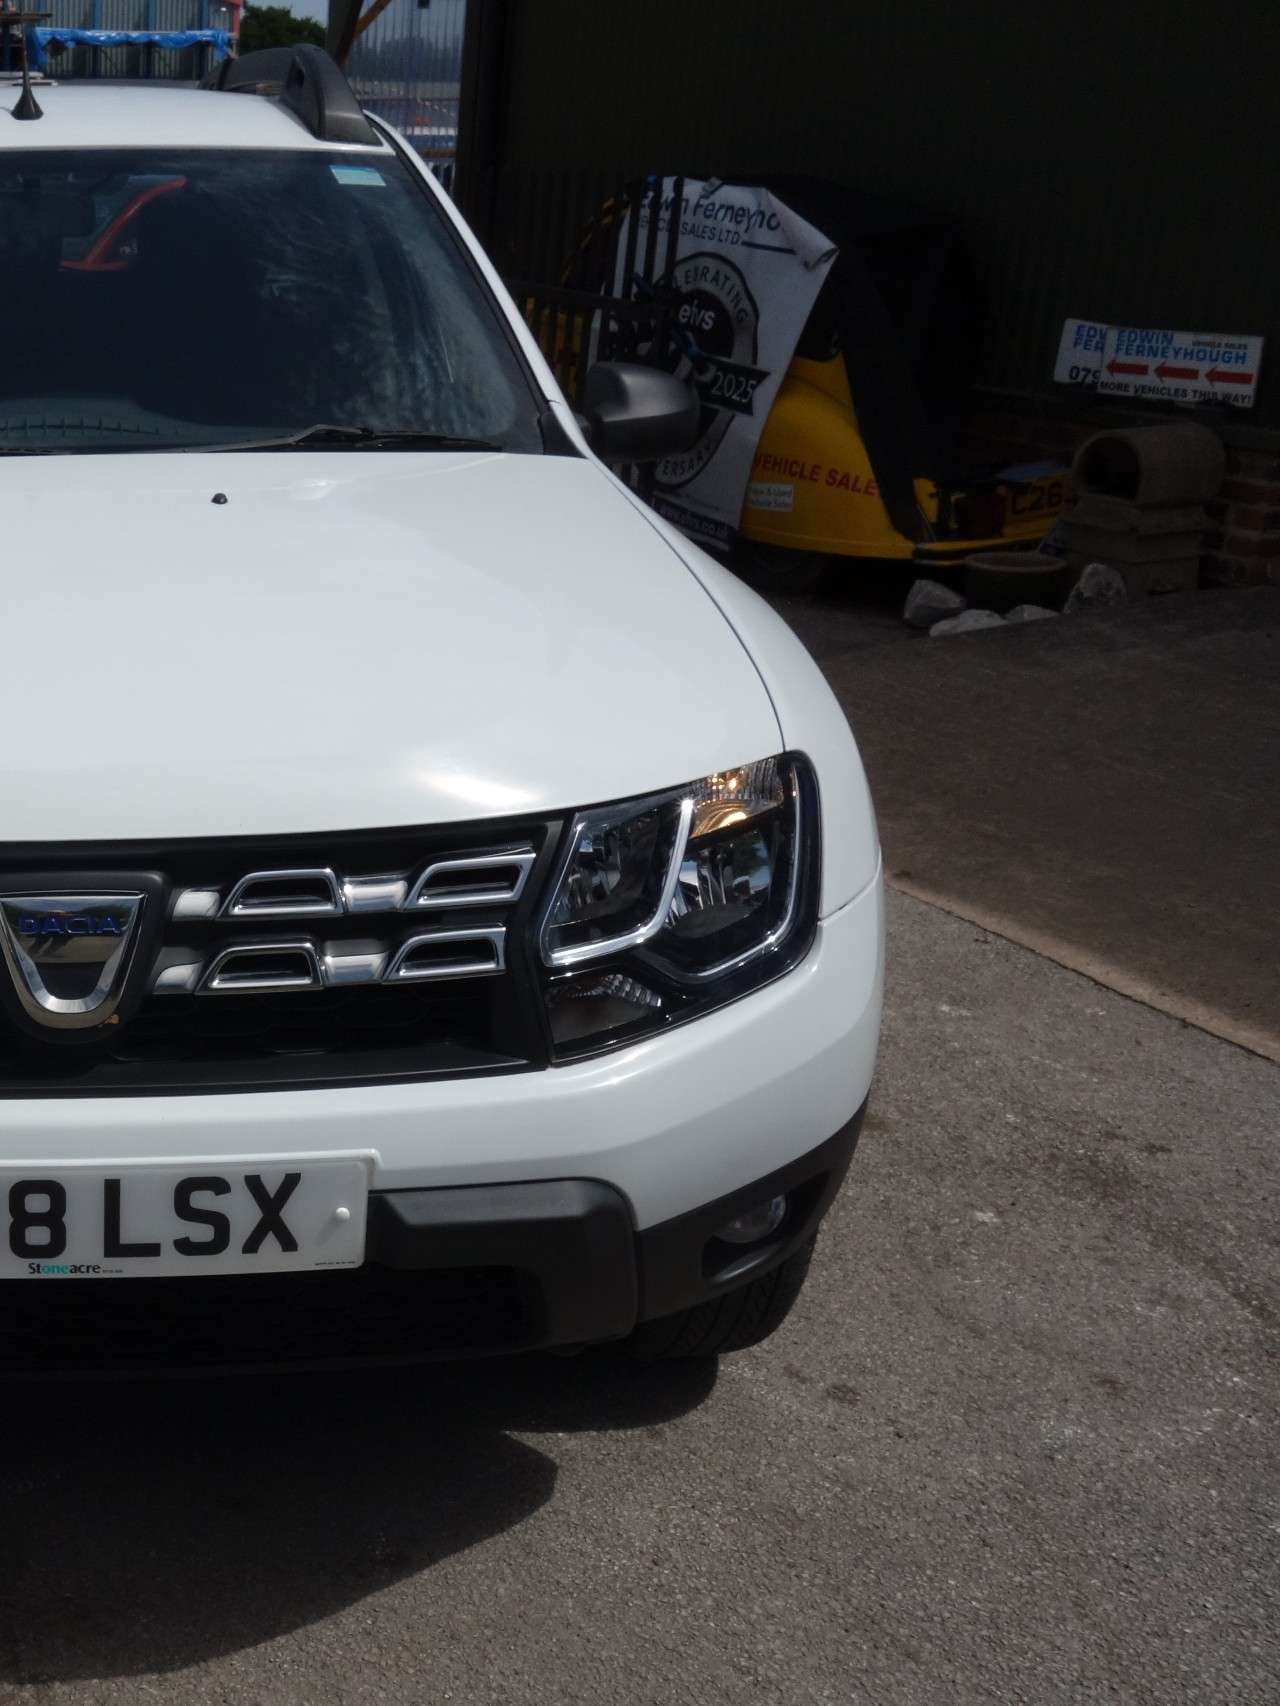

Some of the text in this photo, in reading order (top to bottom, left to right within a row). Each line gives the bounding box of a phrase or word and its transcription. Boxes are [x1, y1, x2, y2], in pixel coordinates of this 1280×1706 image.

[680, 222, 716, 241] SALES
[718, 229, 741, 245] LTD
[1117, 329, 1174, 345] EDWIN
[1115, 343, 1247, 365] FERNEYHOUGH
[711, 371, 757, 403] 2025
[1101, 380, 1131, 393] MORE
[1134, 383, 1188, 398] VEHICLES
[825, 467, 879, 497] SALE
[17, 913, 121, 935] DACIA
[103, 1172, 301, 1258] LSX
[28, 1262, 101, 1275] Stoneacre
